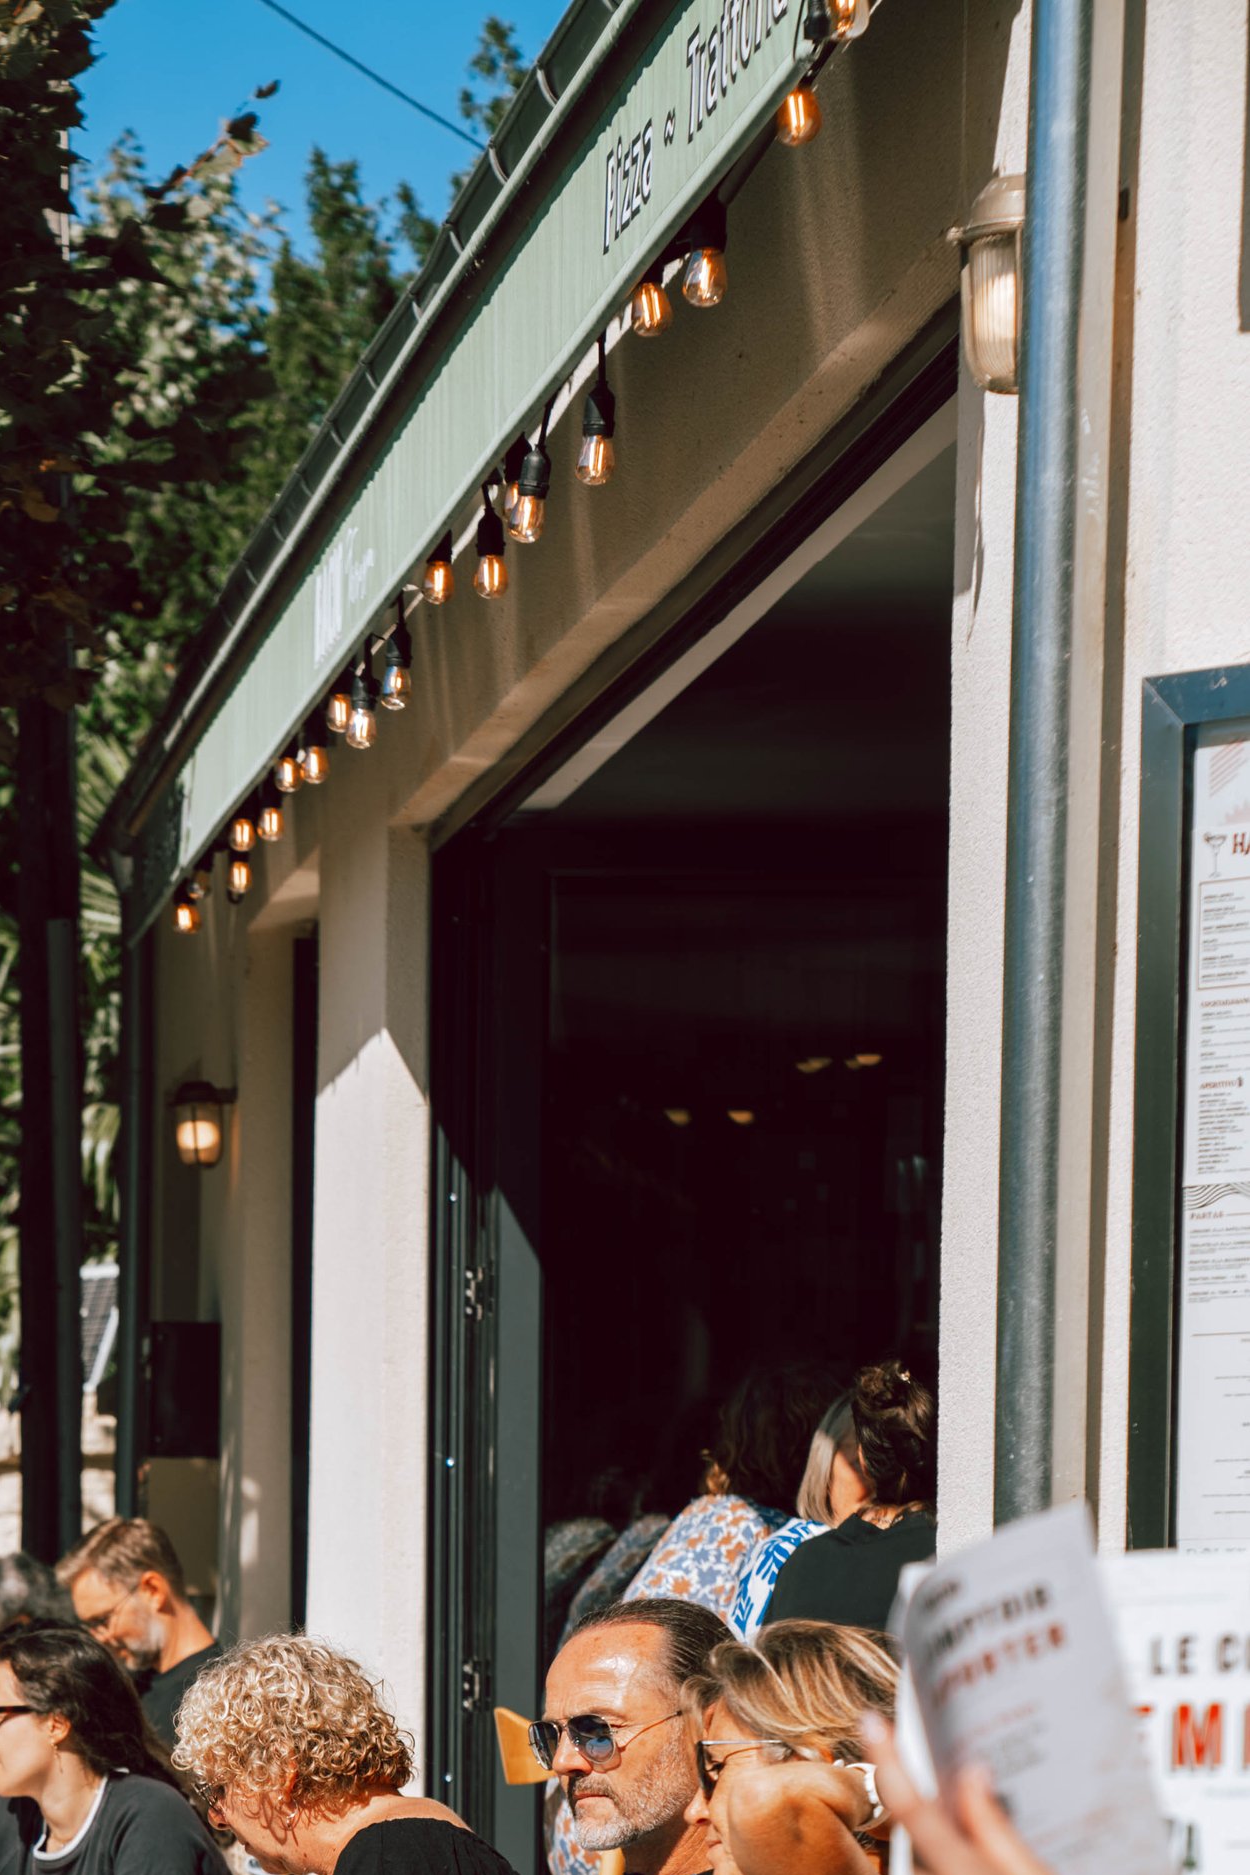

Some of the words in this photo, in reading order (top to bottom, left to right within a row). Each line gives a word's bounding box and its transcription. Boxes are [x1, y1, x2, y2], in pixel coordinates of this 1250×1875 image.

[603, 118, 653, 255] Pizza
[686, 0, 788, 144] Trattor
[1150, 1635, 1196, 1676] LE
[1215, 1633, 1250, 1673] C
